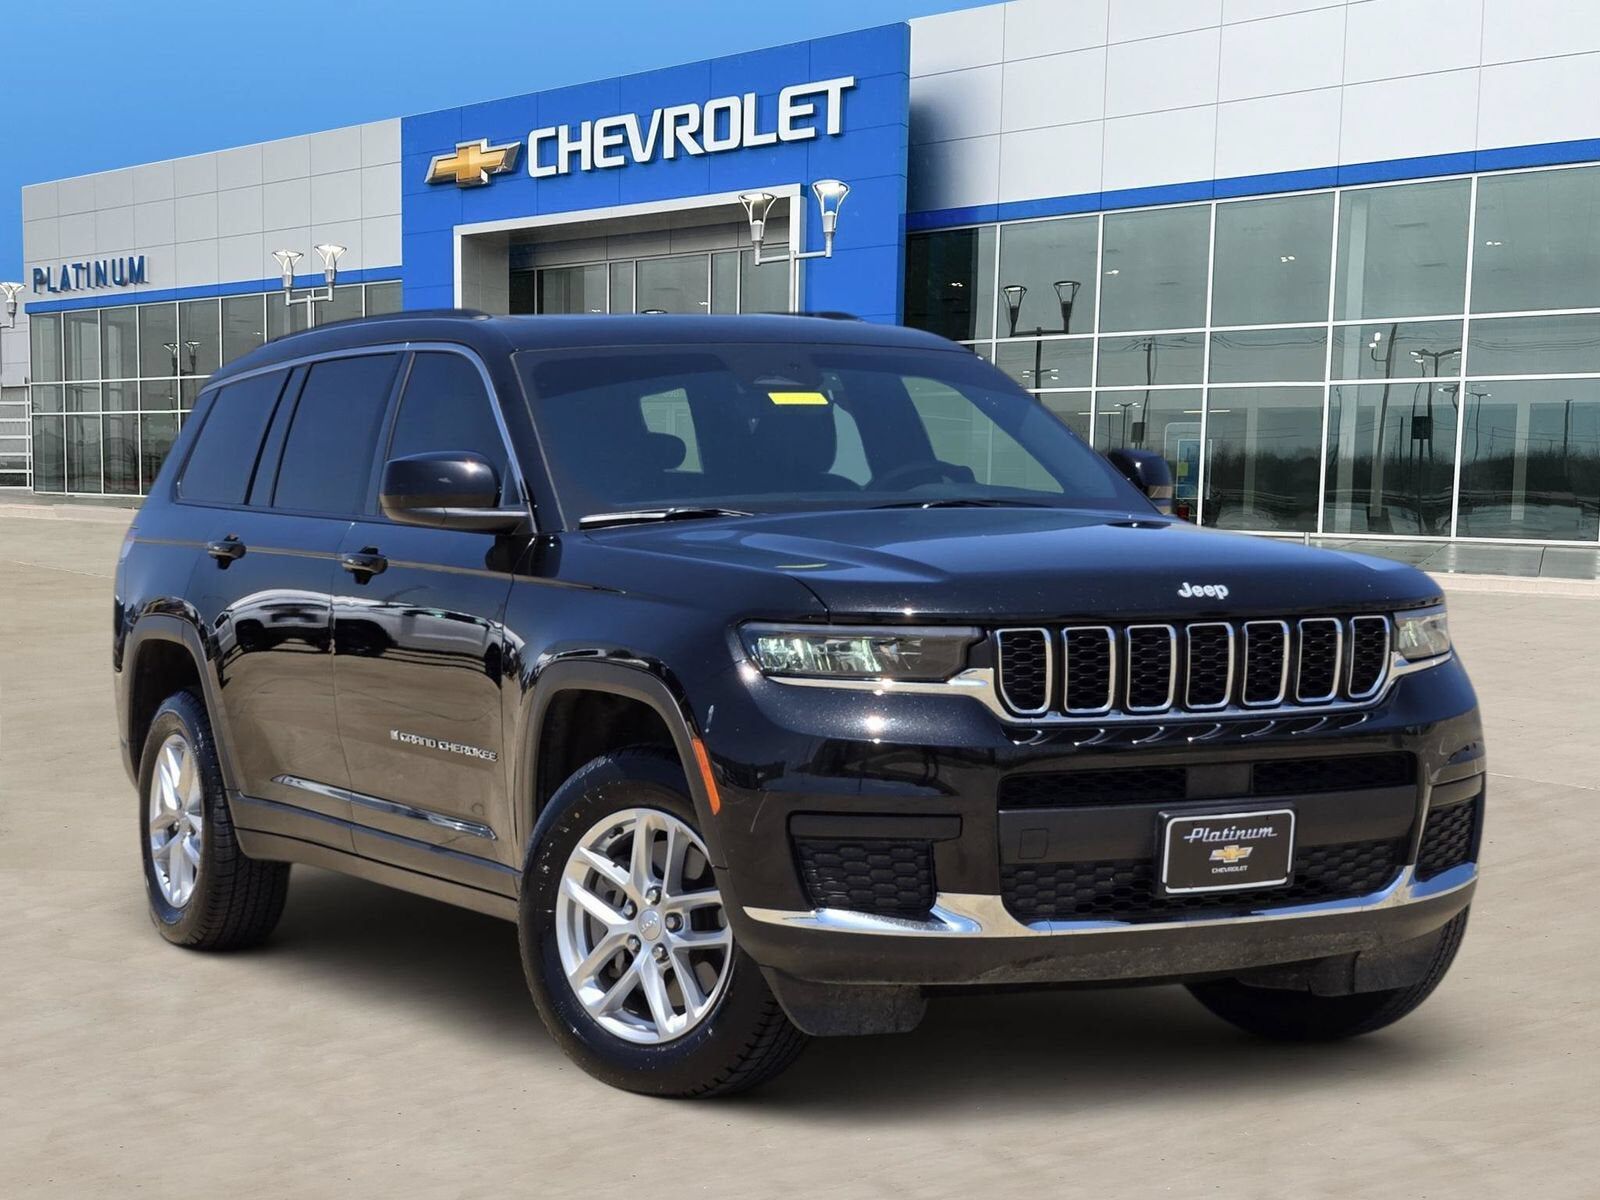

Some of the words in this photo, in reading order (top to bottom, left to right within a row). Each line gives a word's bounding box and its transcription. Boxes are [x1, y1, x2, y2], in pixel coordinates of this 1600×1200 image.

[527, 76, 856, 178] CHEVROLET
[33, 255, 148, 294] PLATINUM
[1177, 582, 1229, 600] Jeep
[400, 732, 436, 748] GRAND
[438, 741, 498, 762] CHEROKEE
[1184, 826, 1278, 843] Platinum
[1211, 865, 1249, 874] CHEVROLET
